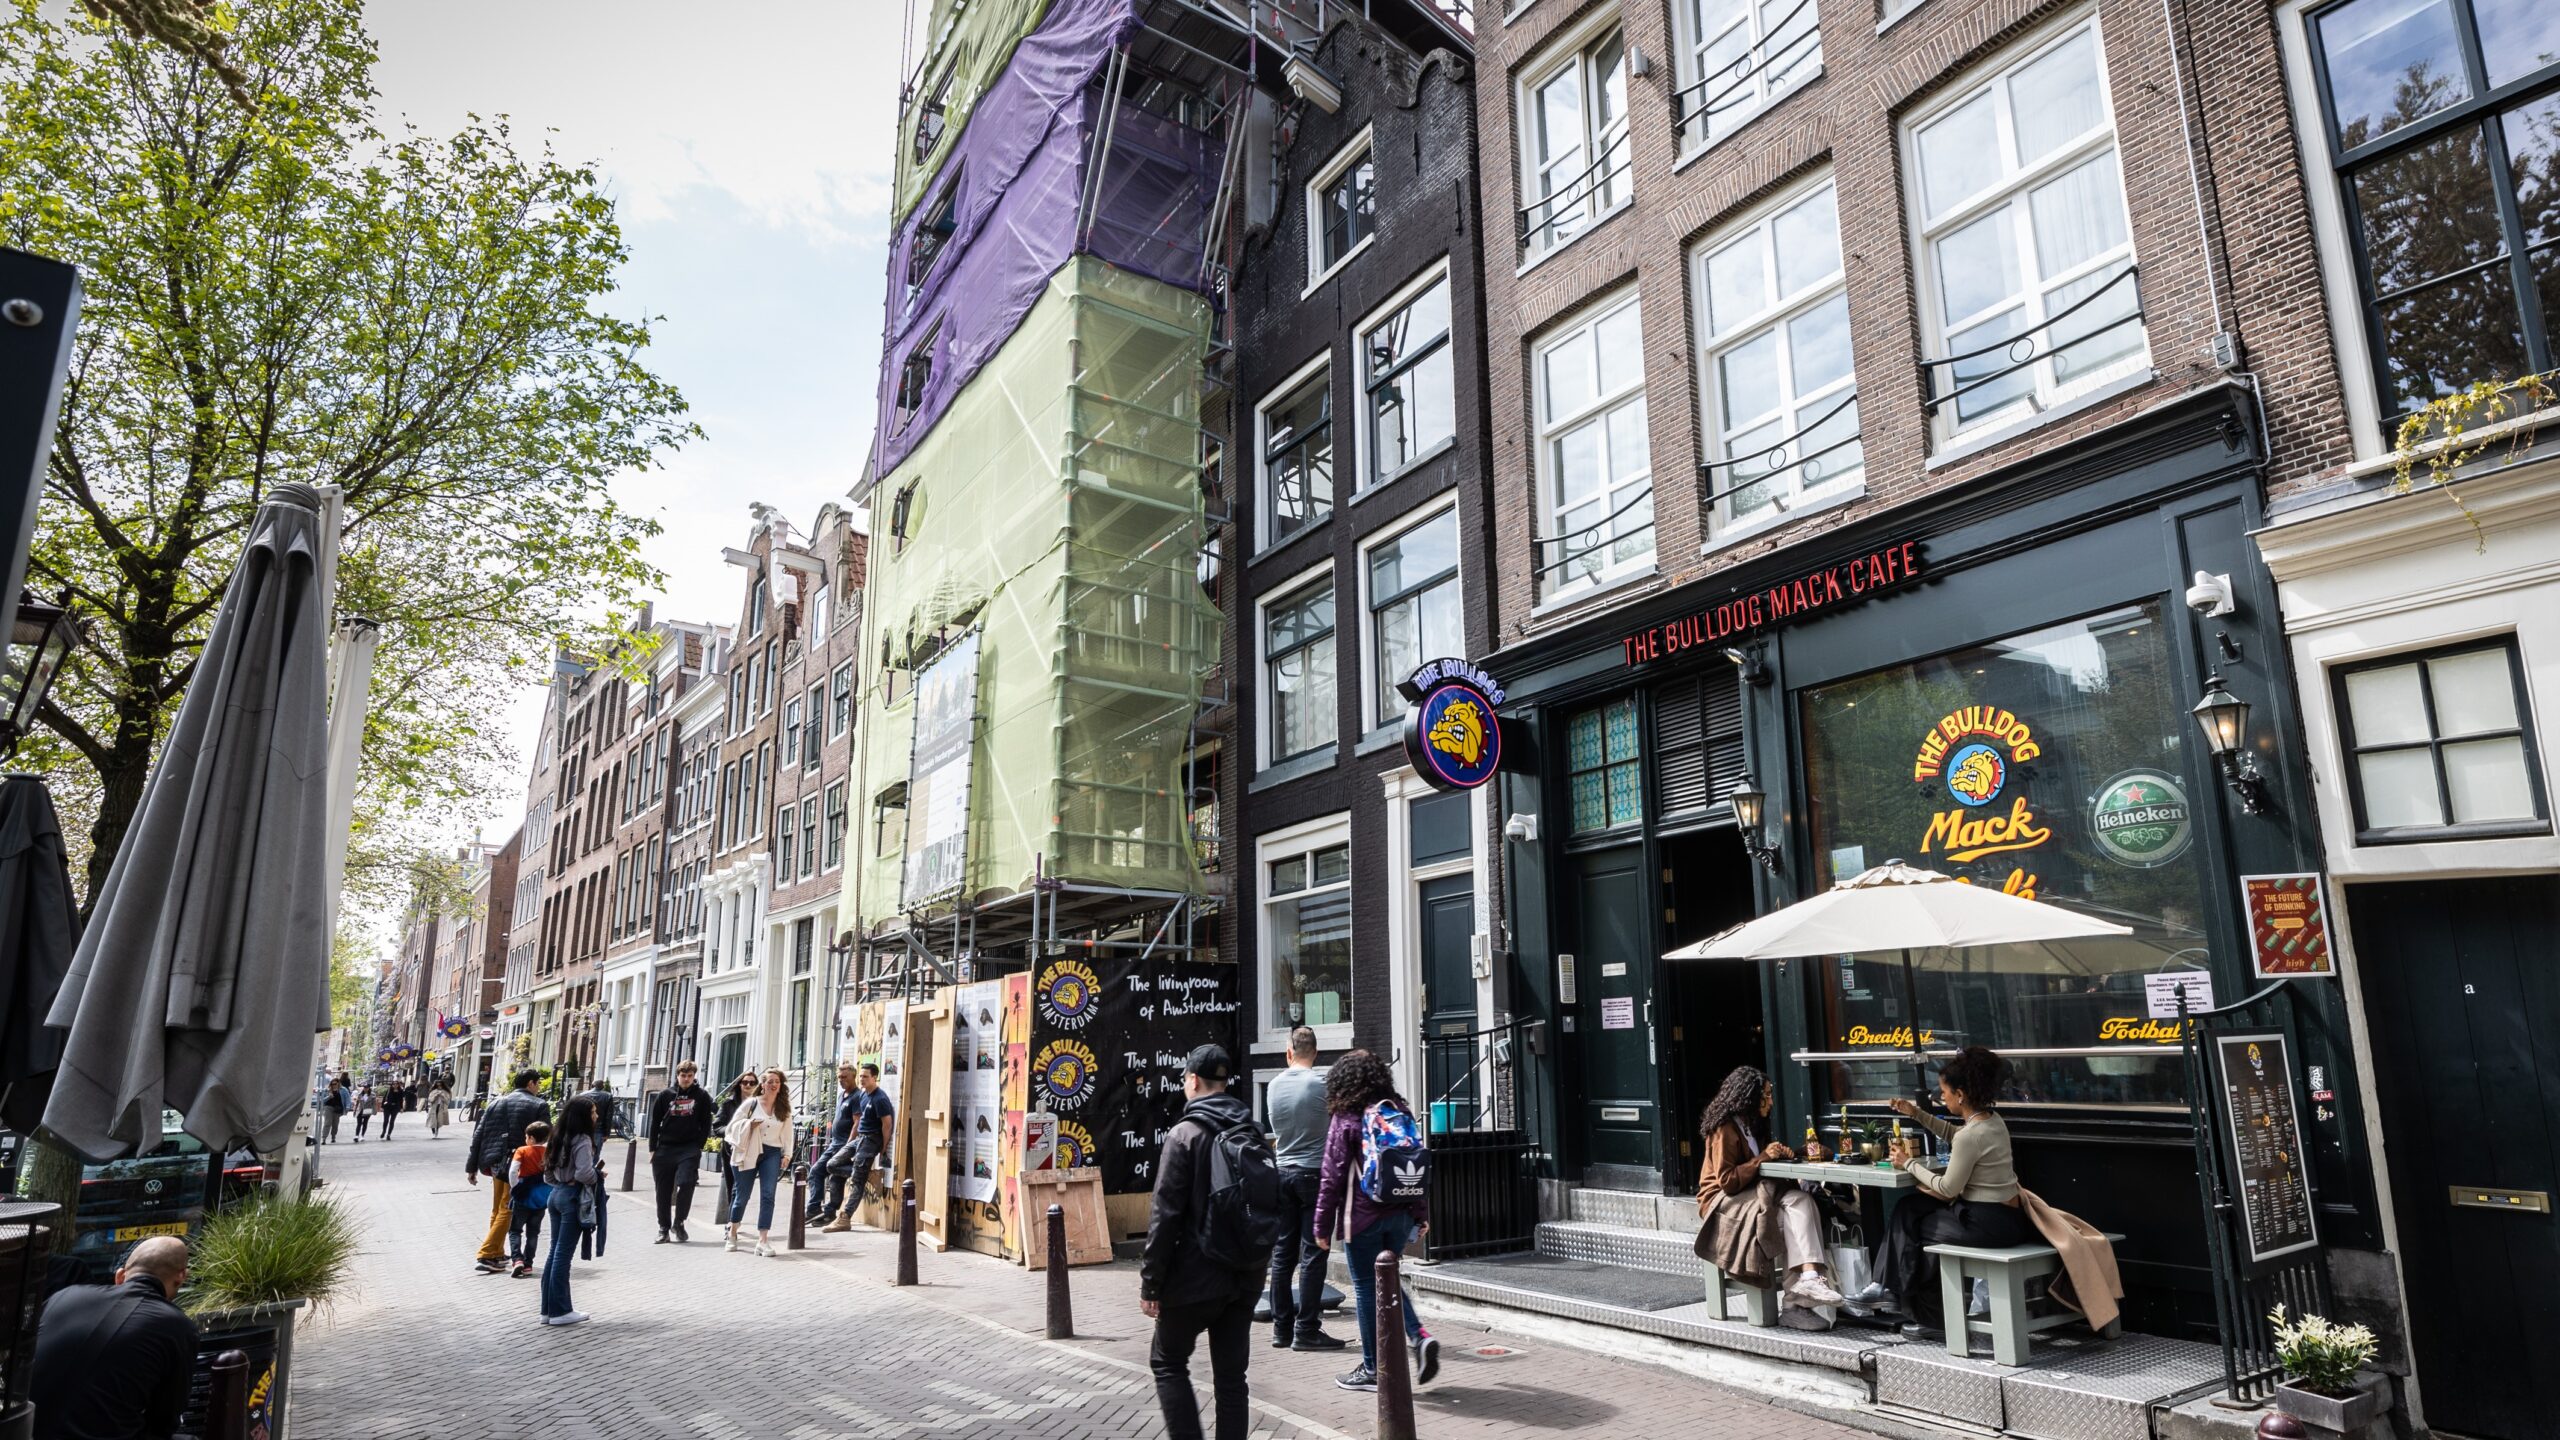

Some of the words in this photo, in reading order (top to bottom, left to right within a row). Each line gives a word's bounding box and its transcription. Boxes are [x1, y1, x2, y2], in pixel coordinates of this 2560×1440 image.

[1623, 629, 1659, 666] THE
[1665, 594, 1762, 653] BULLDOG
[1768, 567, 1843, 621] MACK
[1850, 541, 1918, 594] CAFE
[1414, 663, 1441, 692] THE
[1440, 659, 1505, 706] BULLDOG
[1915, 729, 1948, 782] THE
[1941, 705, 2041, 763] BULLDOG
[1920, 797, 2052, 860] Mack
[2099, 807, 2183, 829] Heineken
[2264, 894, 2277, 902] THE
[2278, 892, 2303, 902] FUTURE
[2264, 903, 2273, 911] OF
[2274, 901, 2306, 911] DRINKING
[1038, 965, 1058, 992] THE
[1055, 960, 1101, 994] BULLDOG
[1127, 975, 1149, 991] The
[1159, 974, 1218, 1001] livingroom
[2465, 984, 2475, 994] a
[1039, 1002, 1098, 1030] AMSTERDAM
[1140, 1005, 1154, 1020] of
[1033, 1045, 1055, 1073] THE
[1051, 1039, 1098, 1073] BULLDOG
[1124, 1051, 1147, 1068] The
[1034, 1083, 1095, 1111] AMSTERDAM
[1136, 1082, 1151, 1098] of
[1058, 1120, 1095, 1154] ULLDOG
[1121, 1131, 1145, 1148] The
[1135, 1161, 1149, 1177] of
[1392, 1187, 1424, 1196] adidas
[248, 1369, 272, 1407] THE
